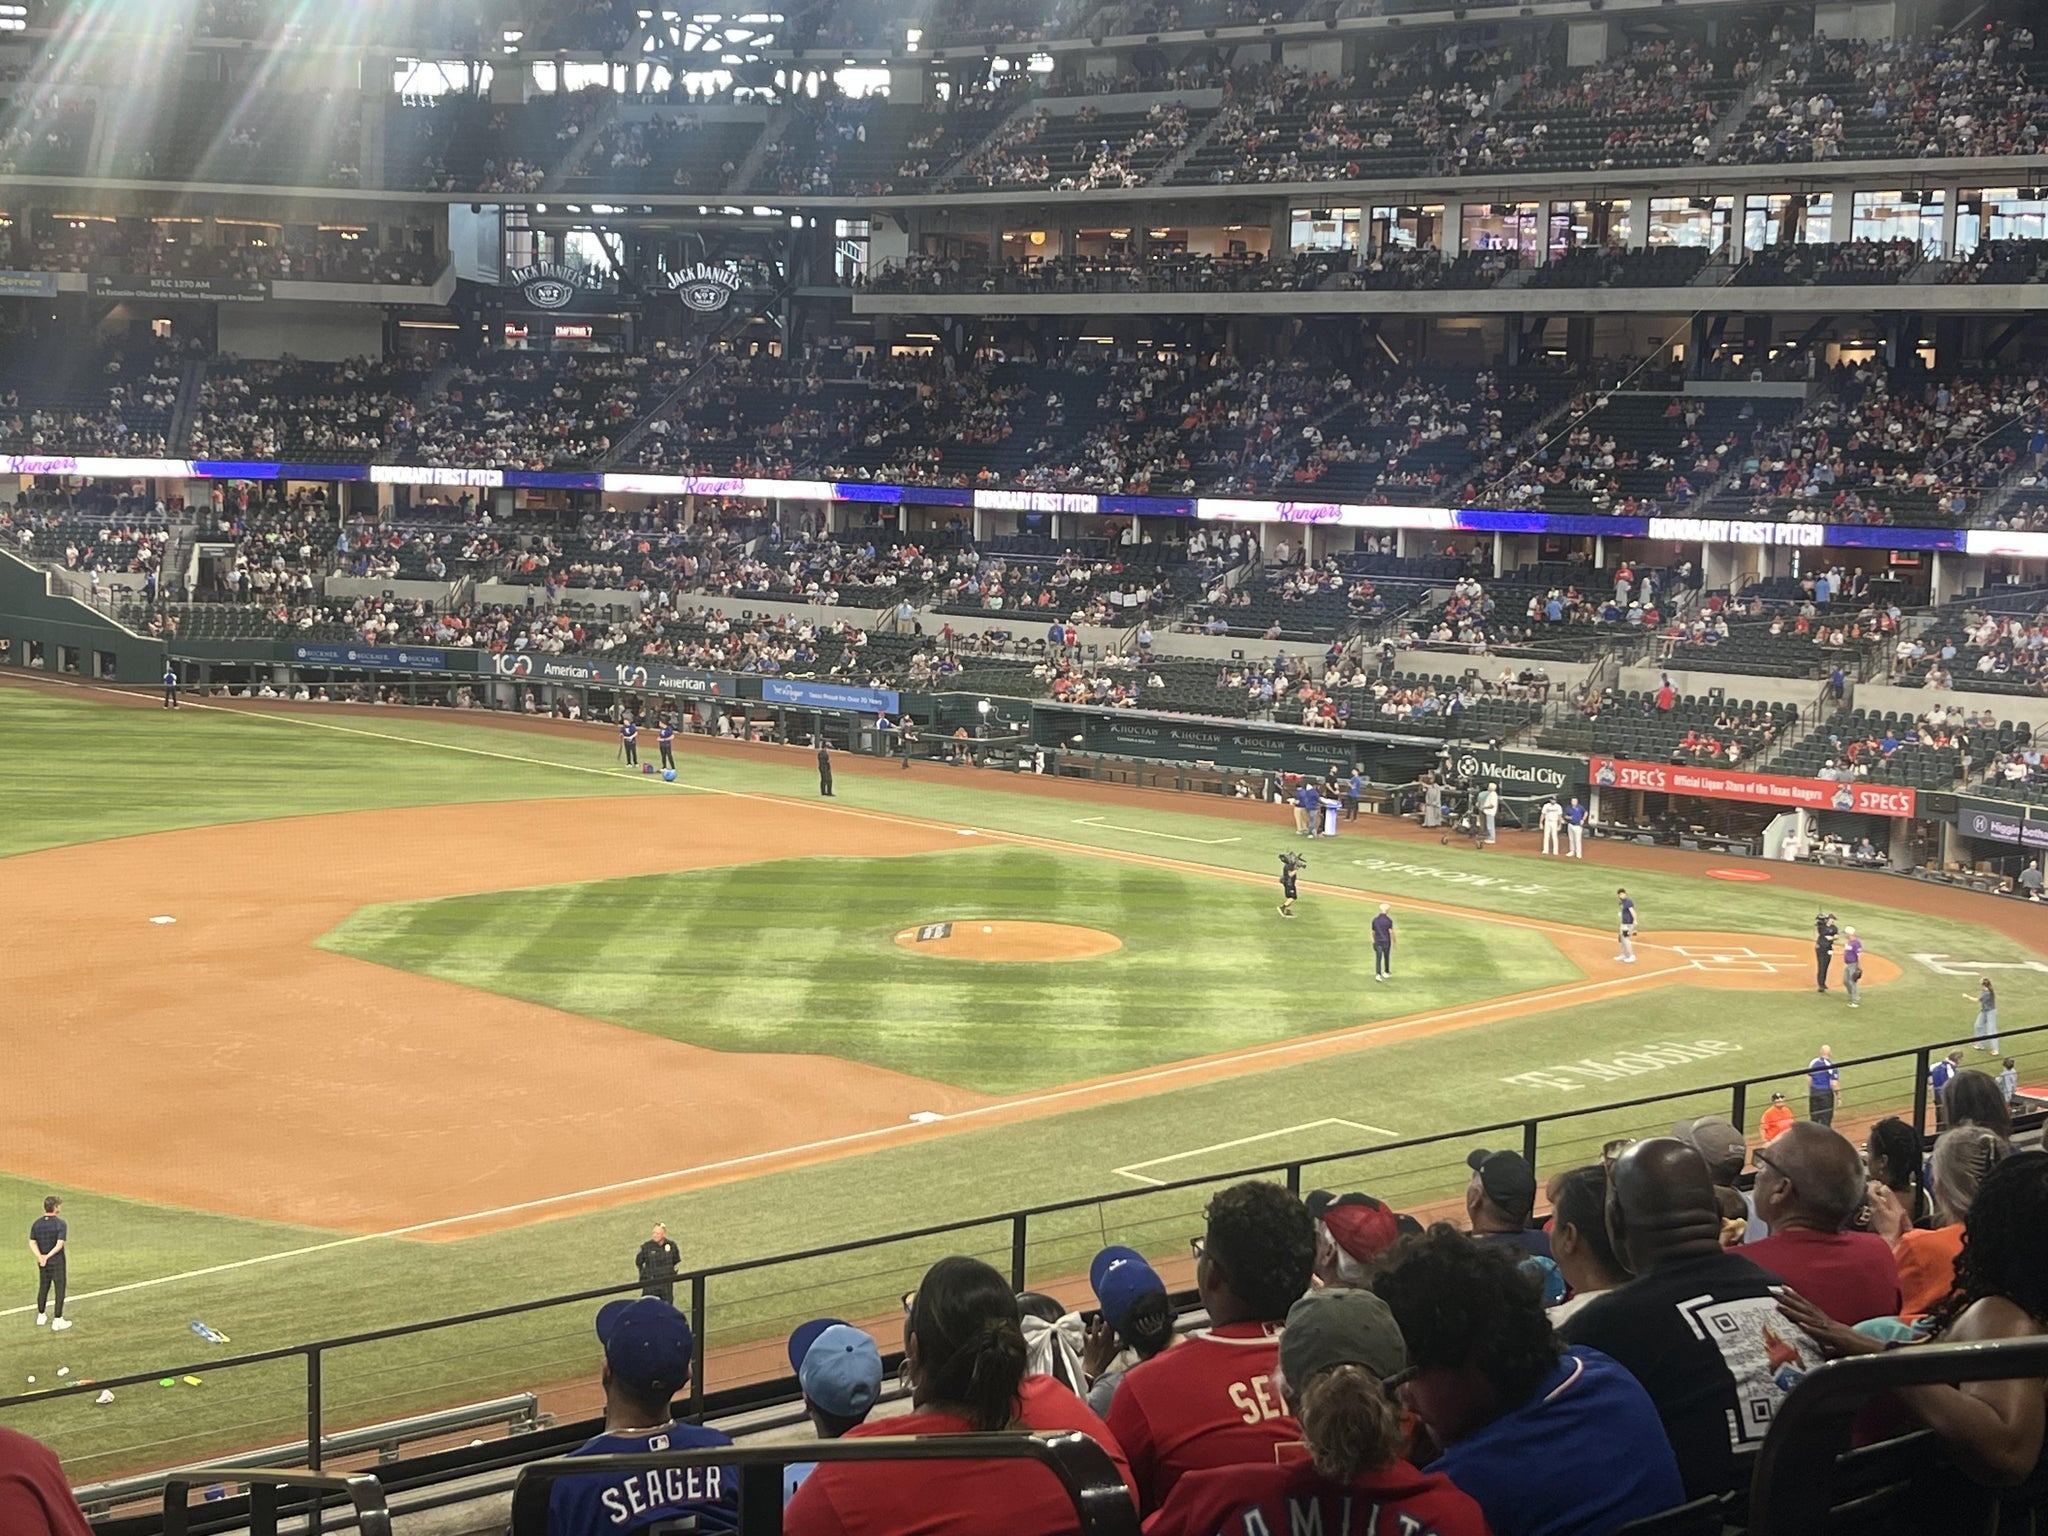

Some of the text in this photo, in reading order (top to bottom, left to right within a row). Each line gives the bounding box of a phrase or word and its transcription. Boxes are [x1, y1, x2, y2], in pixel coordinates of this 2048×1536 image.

[174, 279, 195, 289] 1270
[195, 280, 211, 289] AM
[512, 260, 584, 288] JACK DANIEL'S
[666, 262, 742, 290] JACK DANIEL'S
[7, 456, 78, 474] Rangers
[433, 467, 467, 486] FIRST
[467, 469, 503, 487] PITCH
[682, 476, 745, 496] Rangers
[1031, 491, 1063, 512] FIRST
[1063, 493, 1098, 513] PITCH
[1277, 501, 1343, 523] Rangers
[1730, 521, 1775, 544] FIRST
[1775, 523, 1824, 546] PITCH
[544, 662, 588, 678] American
[659, 674, 705, 691] American
[1110, 724, 1158, 736] CHOCTAW
[1170, 730, 1221, 743] CHOCTAW
[1232, 736, 1285, 749] CHOCTAW
[1297, 742, 1352, 756] CHOCTAW
[1481, 762, 1566, 789] Medical City
[1620, 768, 1910, 812] SPEC'S Official Liquor Store of the Texas Rangers SPEC'S
[601, 1465, 722, 1524] SEAGER
